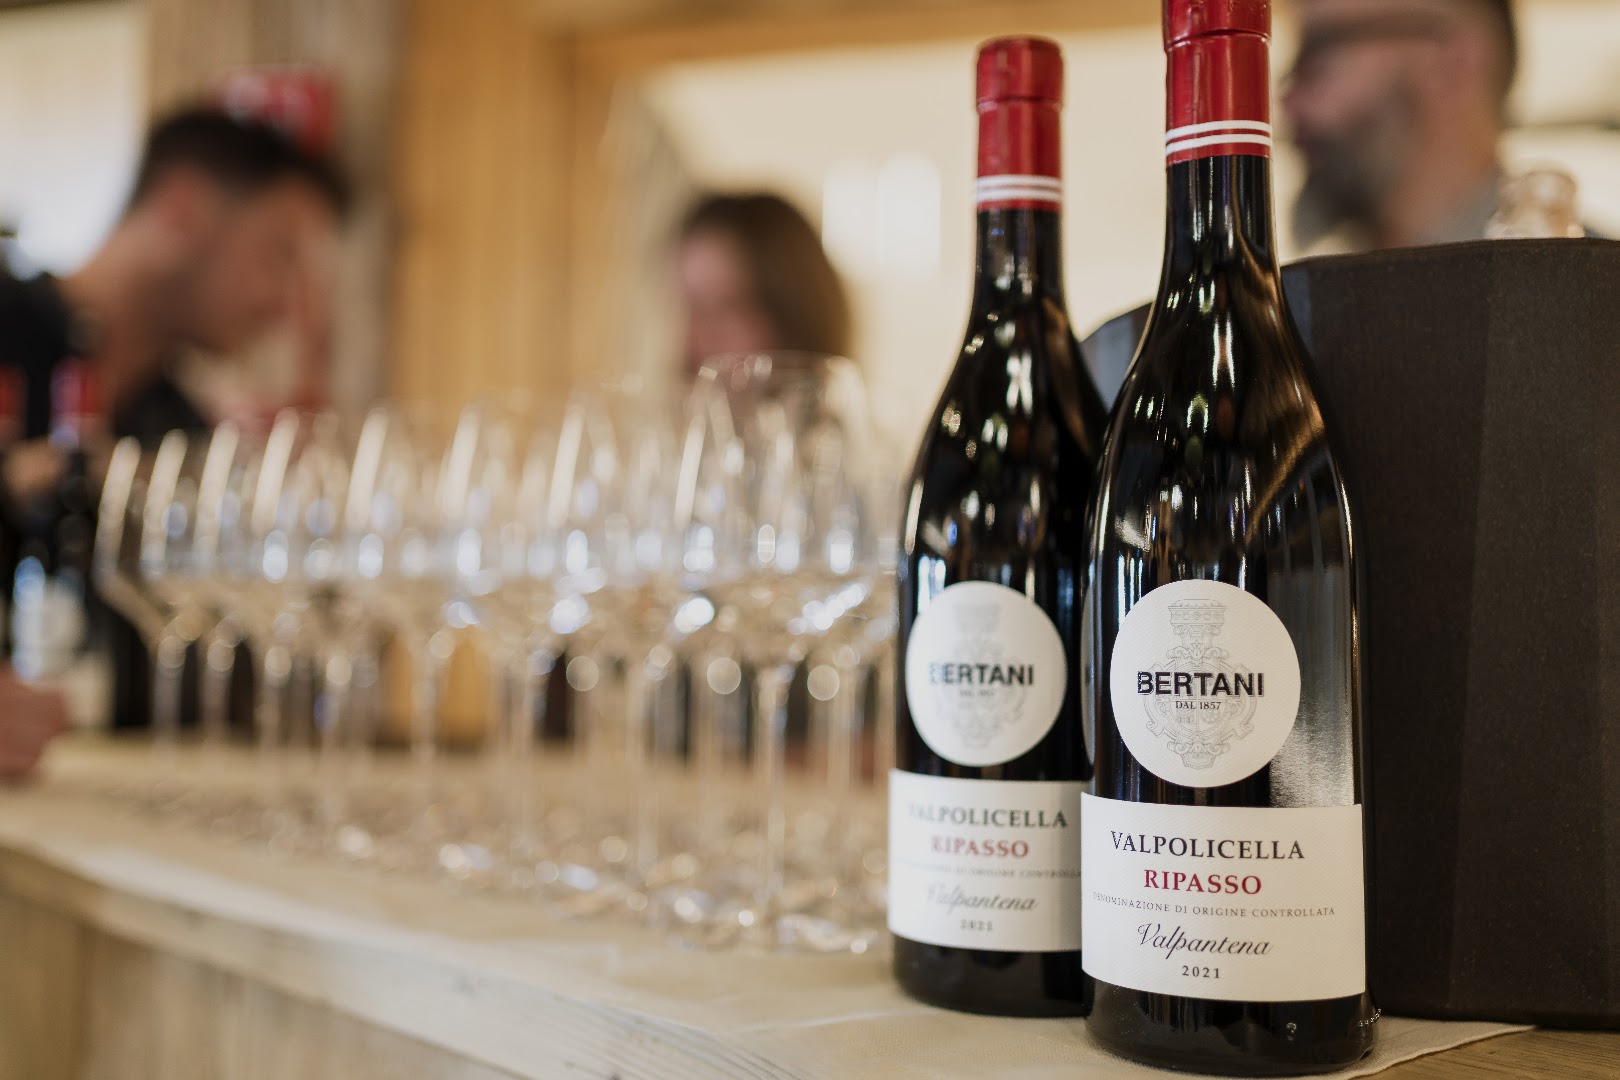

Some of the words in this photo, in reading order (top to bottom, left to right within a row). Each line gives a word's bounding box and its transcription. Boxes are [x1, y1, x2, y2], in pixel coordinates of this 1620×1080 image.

[1137, 670, 1265, 697] BERTANI
[1175, 700, 1197, 710] DAL
[1199, 701, 1222, 710] 1857
[1110, 830, 1305, 860] VALPOLICELLA
[1143, 869, 1262, 895] RIPASSO
[1093, 891, 1170, 912] DENOMINAZIONE
[1175, 904, 1187, 914] DI
[1192, 906, 1247, 917] ORIGINE
[1251, 907, 1335, 918] CONTROLLATA
[1137, 922, 1274, 960] Valpantena
[1181, 965, 1222, 979] 2021
